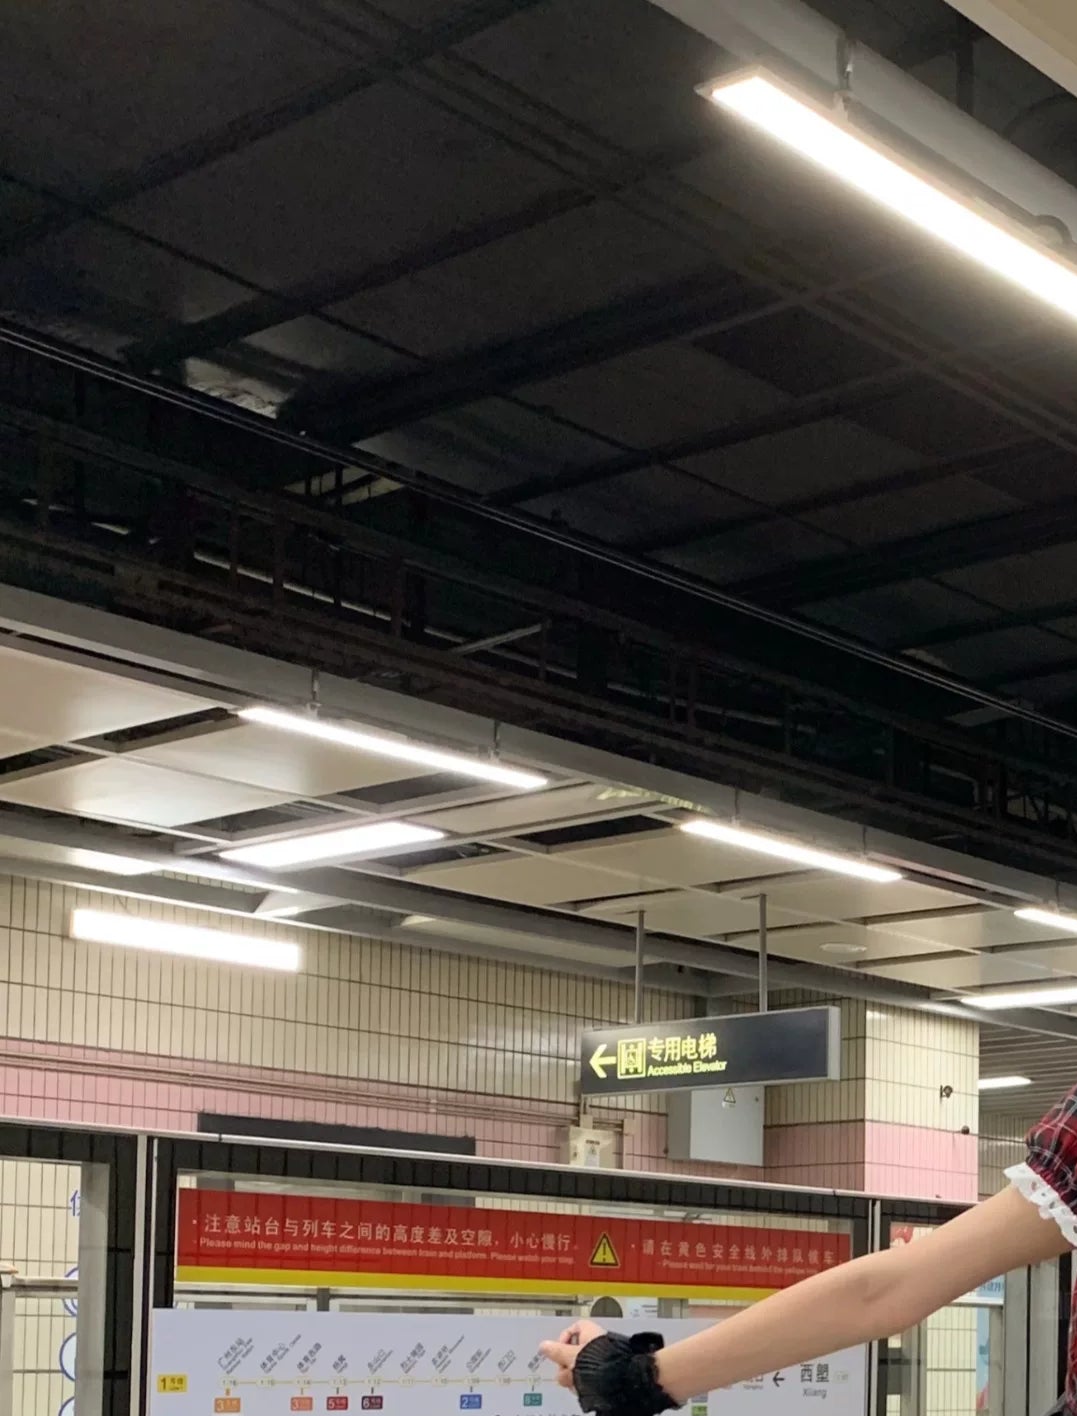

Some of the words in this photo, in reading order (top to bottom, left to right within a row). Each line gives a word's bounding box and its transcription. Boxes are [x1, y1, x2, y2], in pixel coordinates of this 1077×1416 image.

[647, 1032, 717, 1062] 专用电梯
[647, 1063, 692, 1077] Accessible
[692, 1060, 728, 1074] Elevator
[200, 1237, 232, 1248] Please
[234, 1238, 256, 1249] mind
[257, 1240, 273, 1250] the
